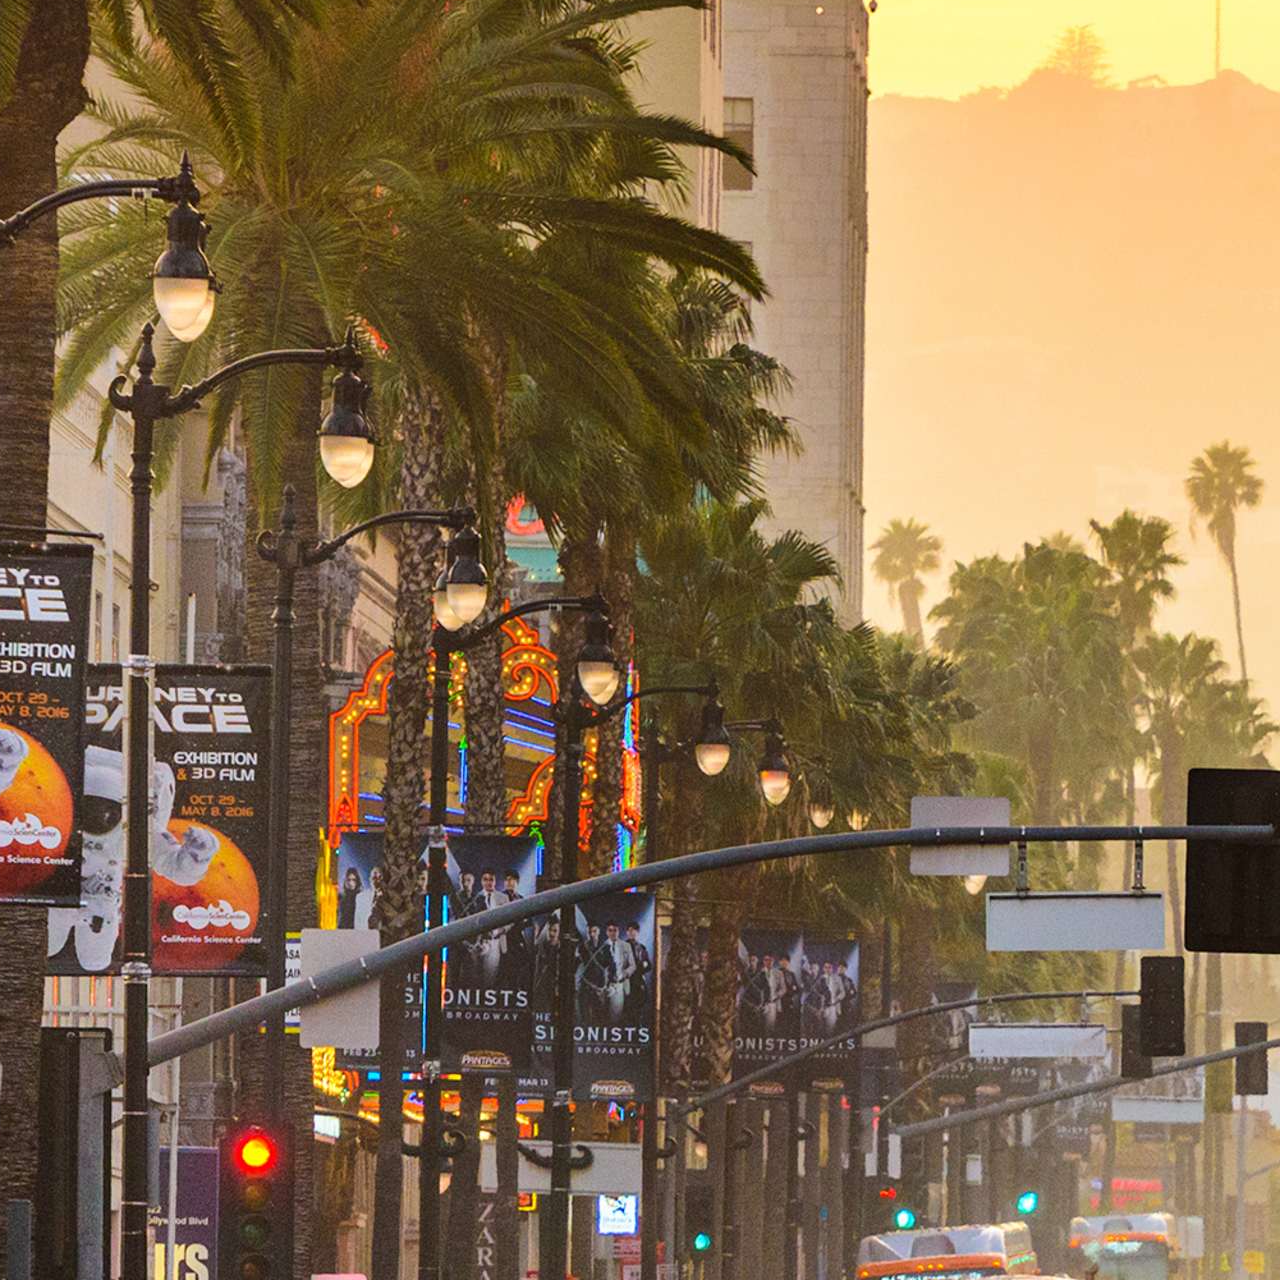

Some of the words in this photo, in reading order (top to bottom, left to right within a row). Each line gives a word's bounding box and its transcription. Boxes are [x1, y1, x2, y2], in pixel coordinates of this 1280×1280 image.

[28, 574, 61, 587] TO
[0, 660, 27, 674] 3D
[31, 662, 73, 678] FILM
[28, 692, 49, 705] 29
[36, 706, 71, 719] 2016
[85, 703, 252, 734] PACE
[174, 750, 258, 766] EXHIBITION
[176, 767, 188, 781] &
[191, 767, 216, 780] 3D
[219, 768, 256, 782] FILM
[218, 796, 236, 807] 29
[181, 805, 209, 818] MAY
[225, 806, 255, 818] 2016
[7, 854, 42, 865] Science
[43, 856, 75, 867] Center
[161, 934, 202, 945] California
[204, 935, 234, 946] Science
[235, 936, 262, 946] Center
[446, 1010, 520, 1021] BROADWAY
[577, 1046, 641, 1056] BROADWAY
[461, 1053, 511, 1066] PANTAGES
[518, 1078, 538, 1086] MAR
[188, 1216, 209, 1226] Blvd
